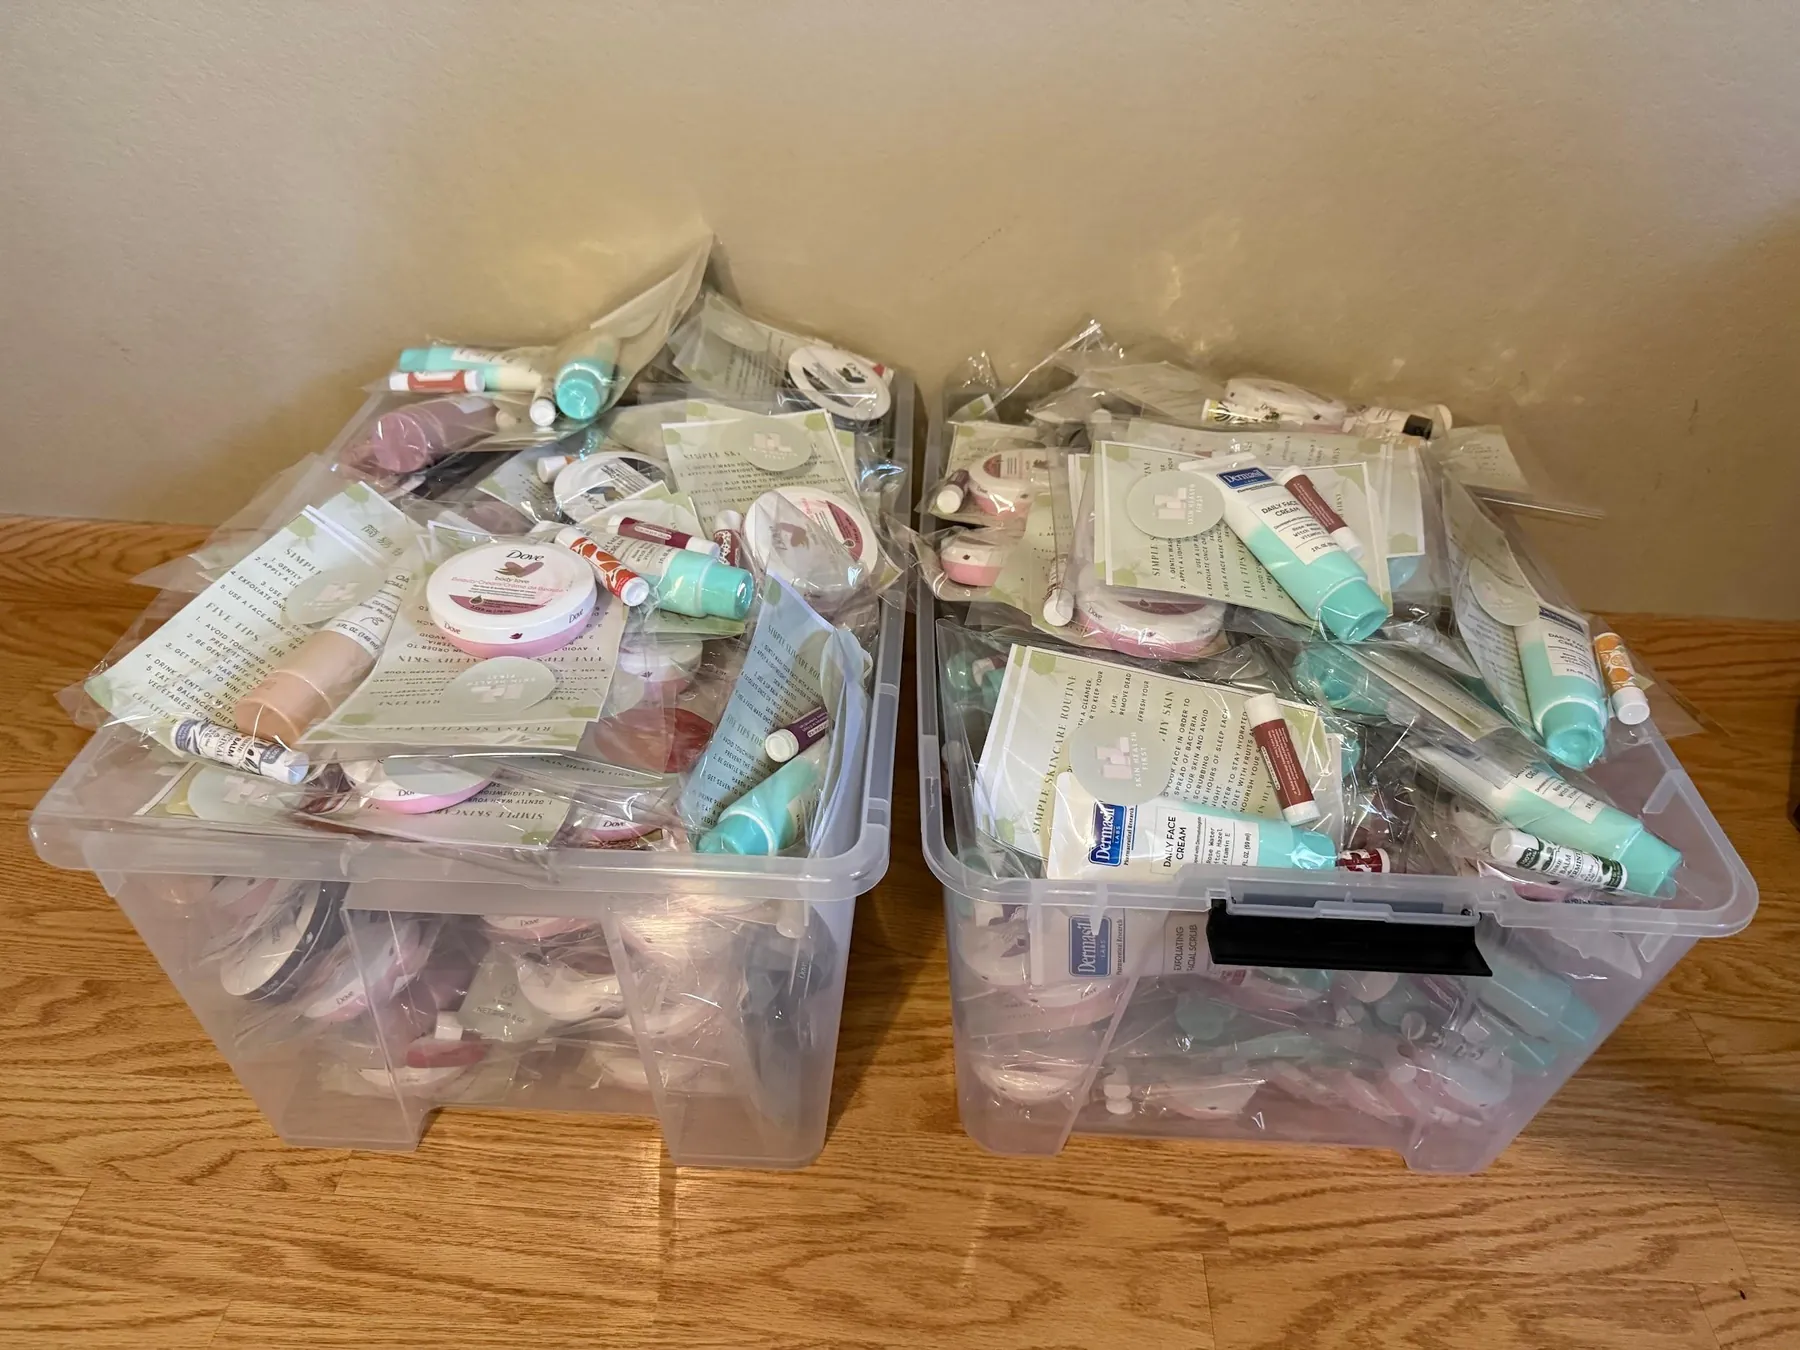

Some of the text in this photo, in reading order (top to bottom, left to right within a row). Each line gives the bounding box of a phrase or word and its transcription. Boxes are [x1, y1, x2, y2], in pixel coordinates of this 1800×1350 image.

[1225, 468, 1264, 484] Dermasil
[1261, 503, 1282, 514] DAILY
[506, 550, 544, 561] Dove
[1150, 546, 1160, 576] SIMPLE
[1169, 552, 1179, 574] GENTLY
[1239, 557, 1248, 575] TIPS
[262, 562, 282, 576] APPLY
[278, 562, 302, 579] GENTLY
[1204, 562, 1212, 590] EXFOLIATE
[238, 576, 272, 600] EXFOLIATE
[268, 586, 282, 597] USE
[1257, 574, 1269, 592] AVOID
[205, 602, 258, 641] FIVE TIPS
[228, 590, 241, 600] USE
[248, 604, 266, 618] FACE
[266, 617, 285, 631] MASK
[568, 608, 583, 623] Dove
[205, 623, 228, 639] AVOID
[419, 632, 446, 640] AVOID
[442, 621, 461, 634] Dove
[174, 648, 189, 658] GET
[421, 644, 450, 652] ORDER
[217, 665, 241, 682] HARSH
[154, 671, 170, 685] EAT
[215, 711, 232, 724] DIET
[1119, 673, 1131, 715] REMOVE DEAD
[1162, 691, 1173, 715] SKIN
[227, 737, 241, 757] BALM
[1171, 746, 1181, 765] FACE
[1179, 709, 1188, 733] ORDER
[1231, 751, 1240, 770] STAY
[1236, 711, 1249, 749] HYDRATED
[1032, 676, 1076, 834] SIMPLE SKINCARE ROUTINE
[1139, 747, 1148, 771] FIRST
[1174, 766, 1186, 795] SPREAD
[1185, 714, 1197, 751] BACTERIA.
[1185, 773, 1195, 793] YOUR
[1191, 752, 1199, 770] SKIN
[1199, 709, 1208, 732] AVOID
[1205, 767, 1217, 793] HOURS
[1215, 730, 1224, 751] SLEEP
[1220, 706, 1231, 728] EACH
[1231, 739, 1253, 806] DIET WITH FRUITS
[1240, 756, 1260, 812] NOURISH YOUR
[499, 811, 542, 819] SIMPLE
[1096, 805, 1115, 860] Dermasil
[1163, 816, 1178, 867] DAILY FACE
[1176, 827, 1186, 860] CREAM
[1208, 827, 1218, 846] Water
[1213, 828, 1226, 866] itch Hazel
[1559, 854, 1571, 874] BALM
[1078, 921, 1098, 972] Dermasil
[1174, 927, 1184, 970] EXFOLIATING
[1188, 924, 1197, 951] SCRUB
